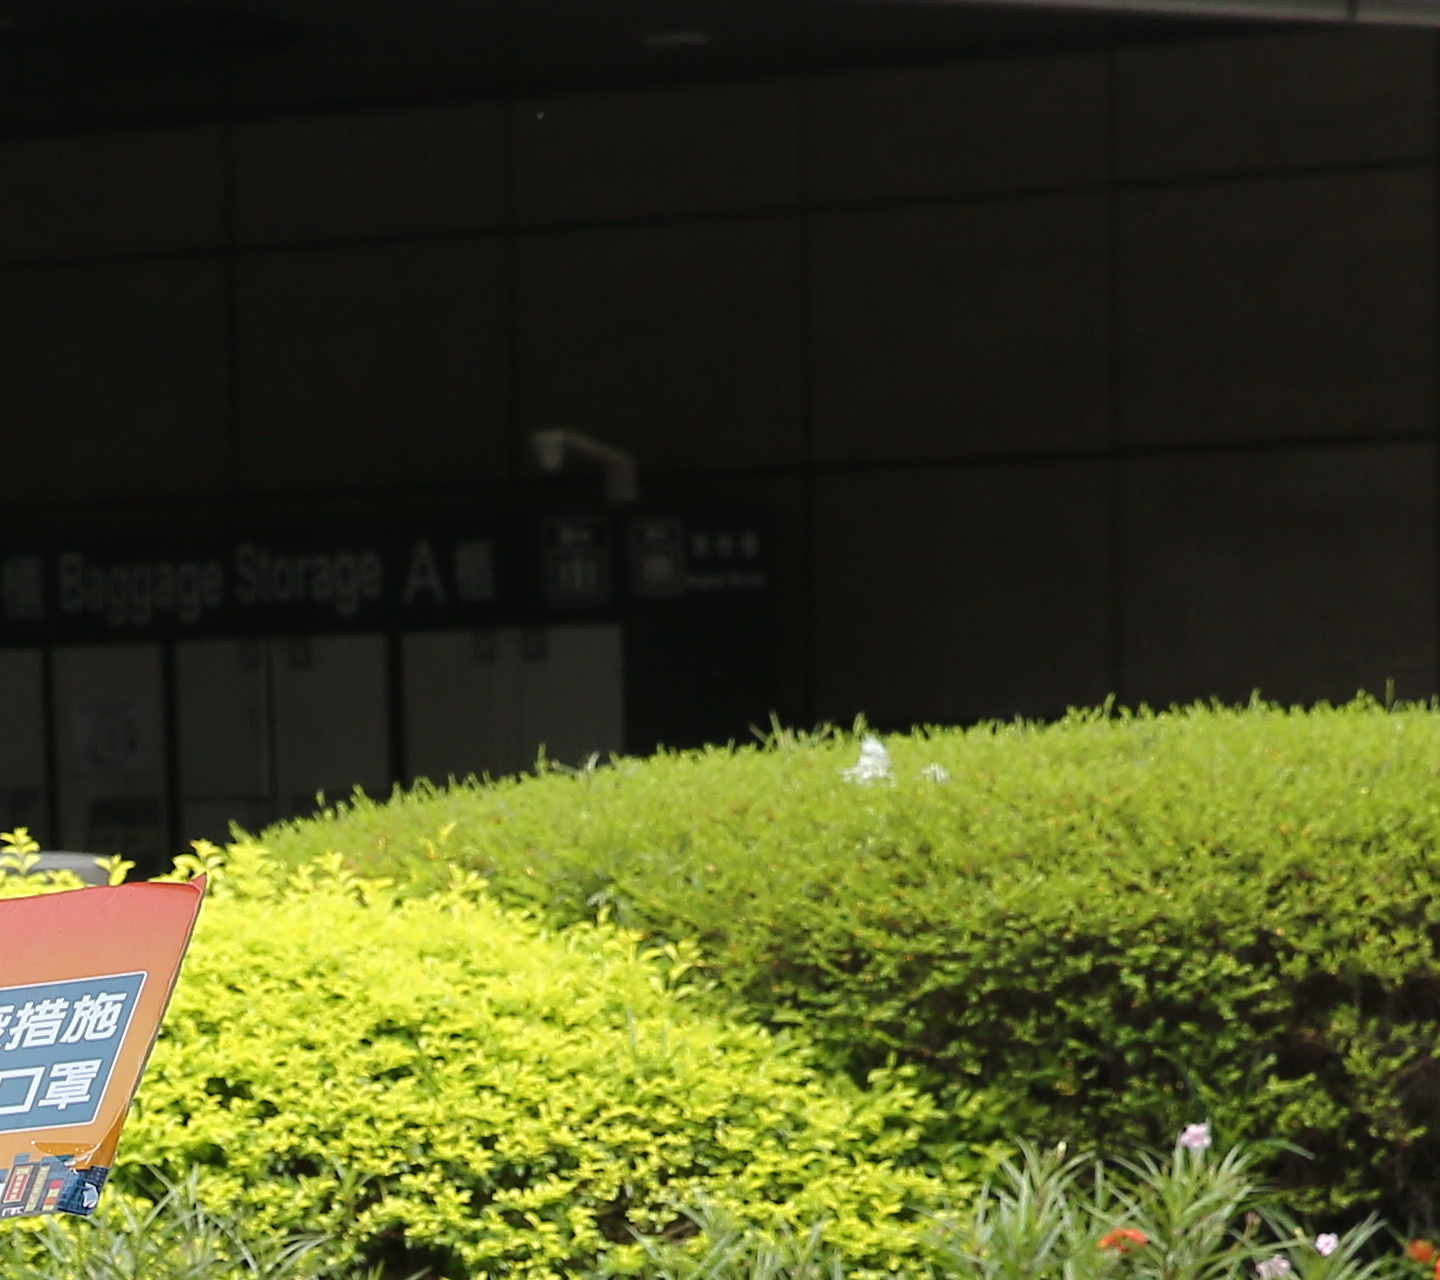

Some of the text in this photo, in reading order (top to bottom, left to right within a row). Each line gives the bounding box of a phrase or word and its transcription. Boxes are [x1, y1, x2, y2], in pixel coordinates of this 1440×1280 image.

[59, 552, 223, 625] Baggage
[234, 541, 382, 616] Storage
[403, 539, 446, 605] A
